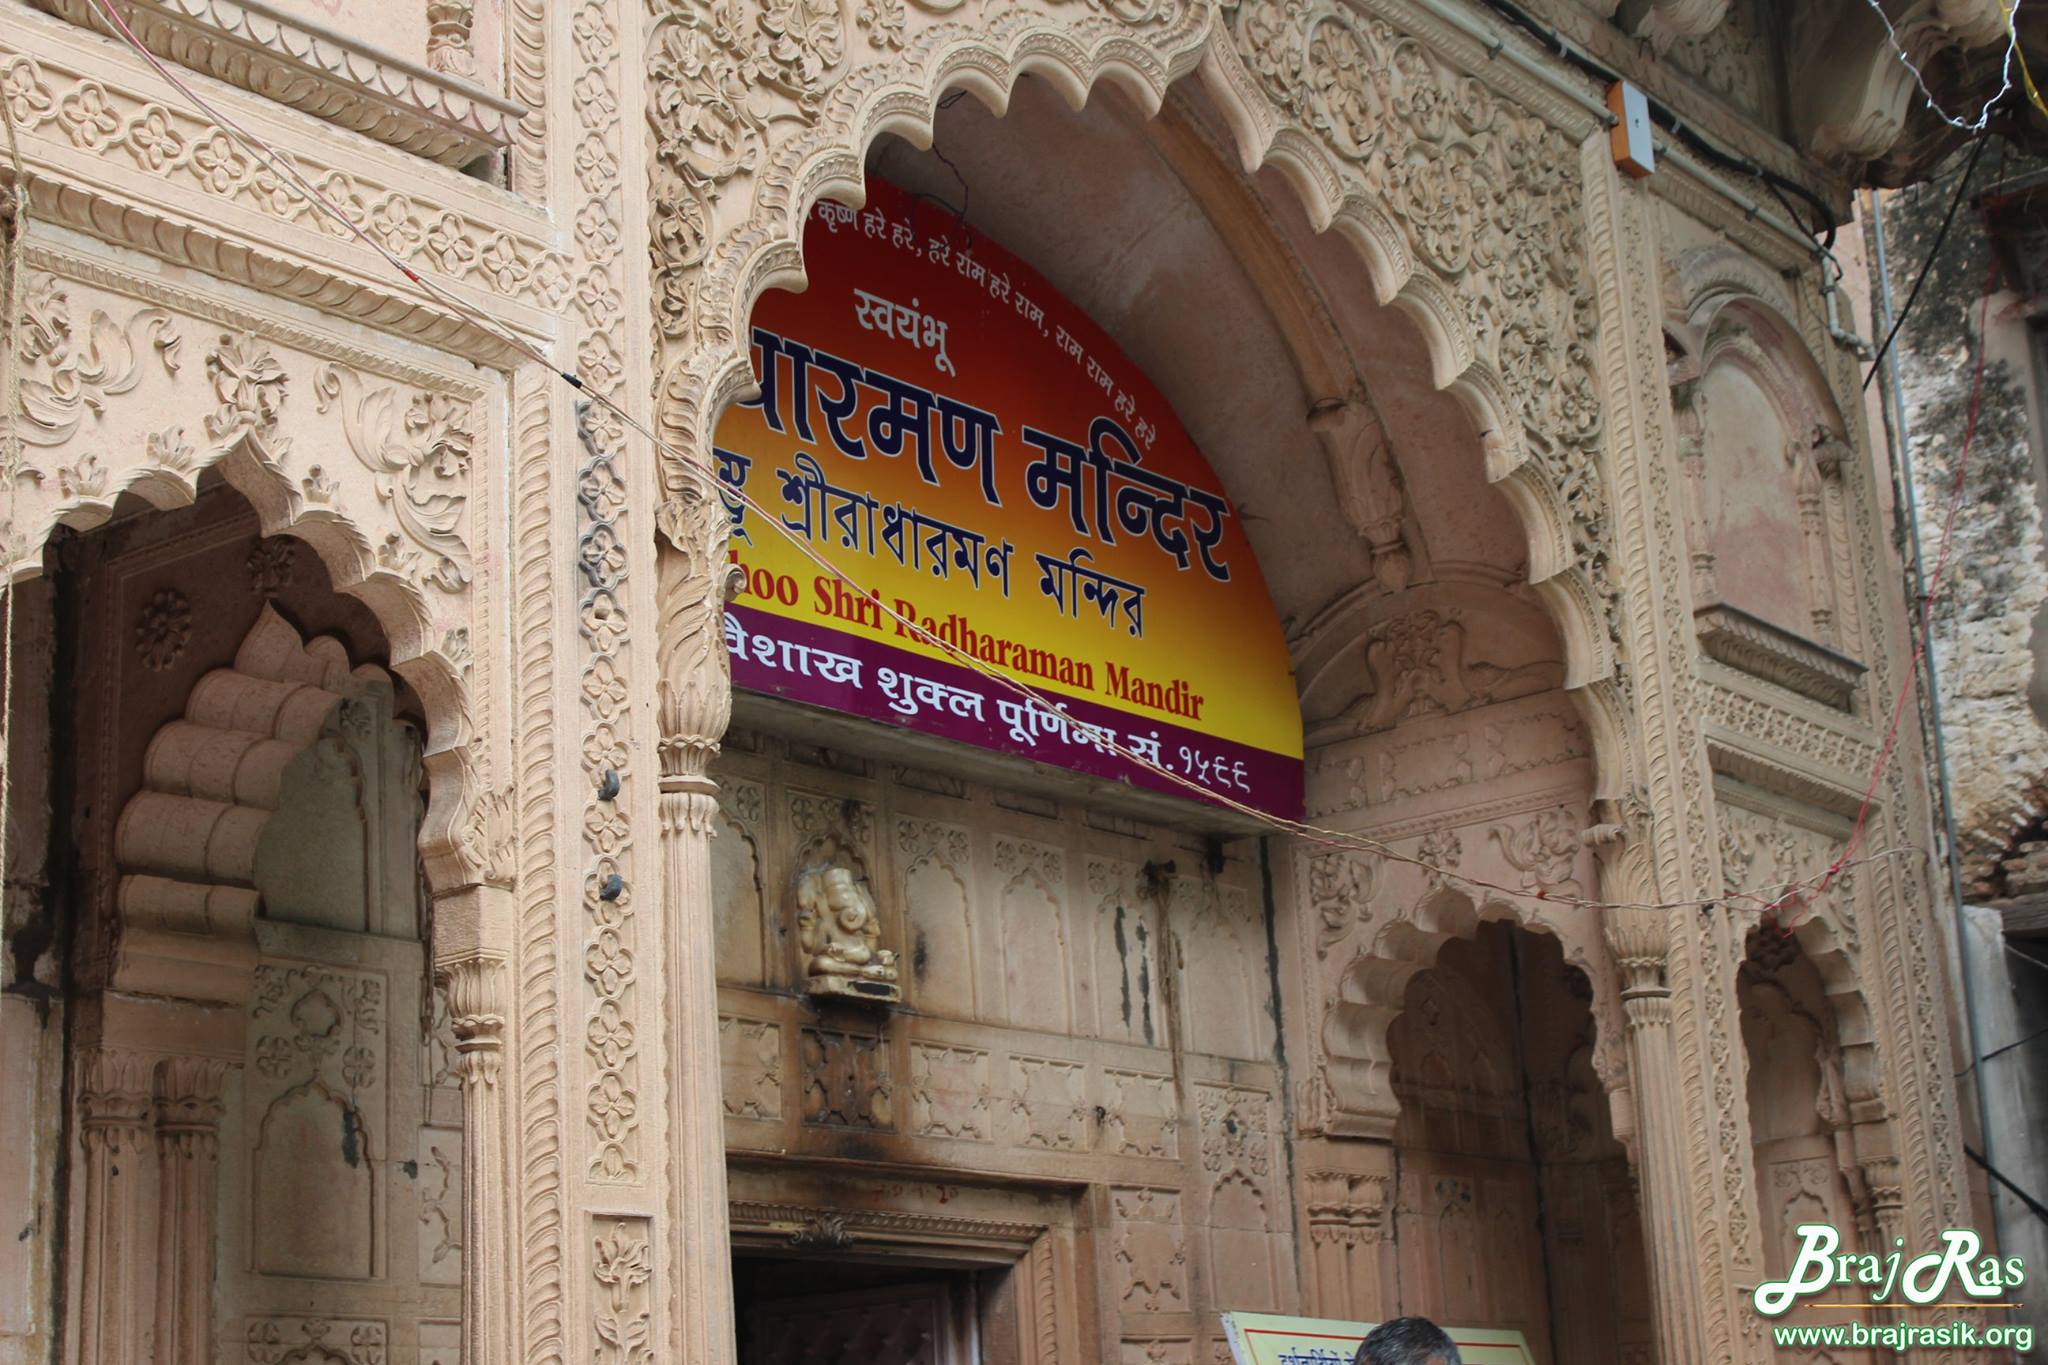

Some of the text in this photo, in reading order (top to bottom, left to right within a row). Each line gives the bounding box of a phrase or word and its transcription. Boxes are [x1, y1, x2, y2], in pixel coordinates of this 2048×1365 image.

[817, 200, 859, 233] कृष्ण
[863, 207, 887, 239] हरे
[929, 235, 951, 267] हरे
[956, 252, 986, 287] राम
[989, 272, 1011, 304] हरे
[1056, 324, 1084, 365] राम
[1087, 356, 1114, 397] राम
[853, 287, 956, 378] स्वयंभू
[1021, 415, 1231, 583] मन्दिर
[813, 575, 883, 631] Shri
[893, 598, 1095, 692] Radharaman
[1104, 661, 1205, 722] Mandir
[1034, 546, 1147, 640] মন্দির
[877, 667, 986, 723] शुक्ल
